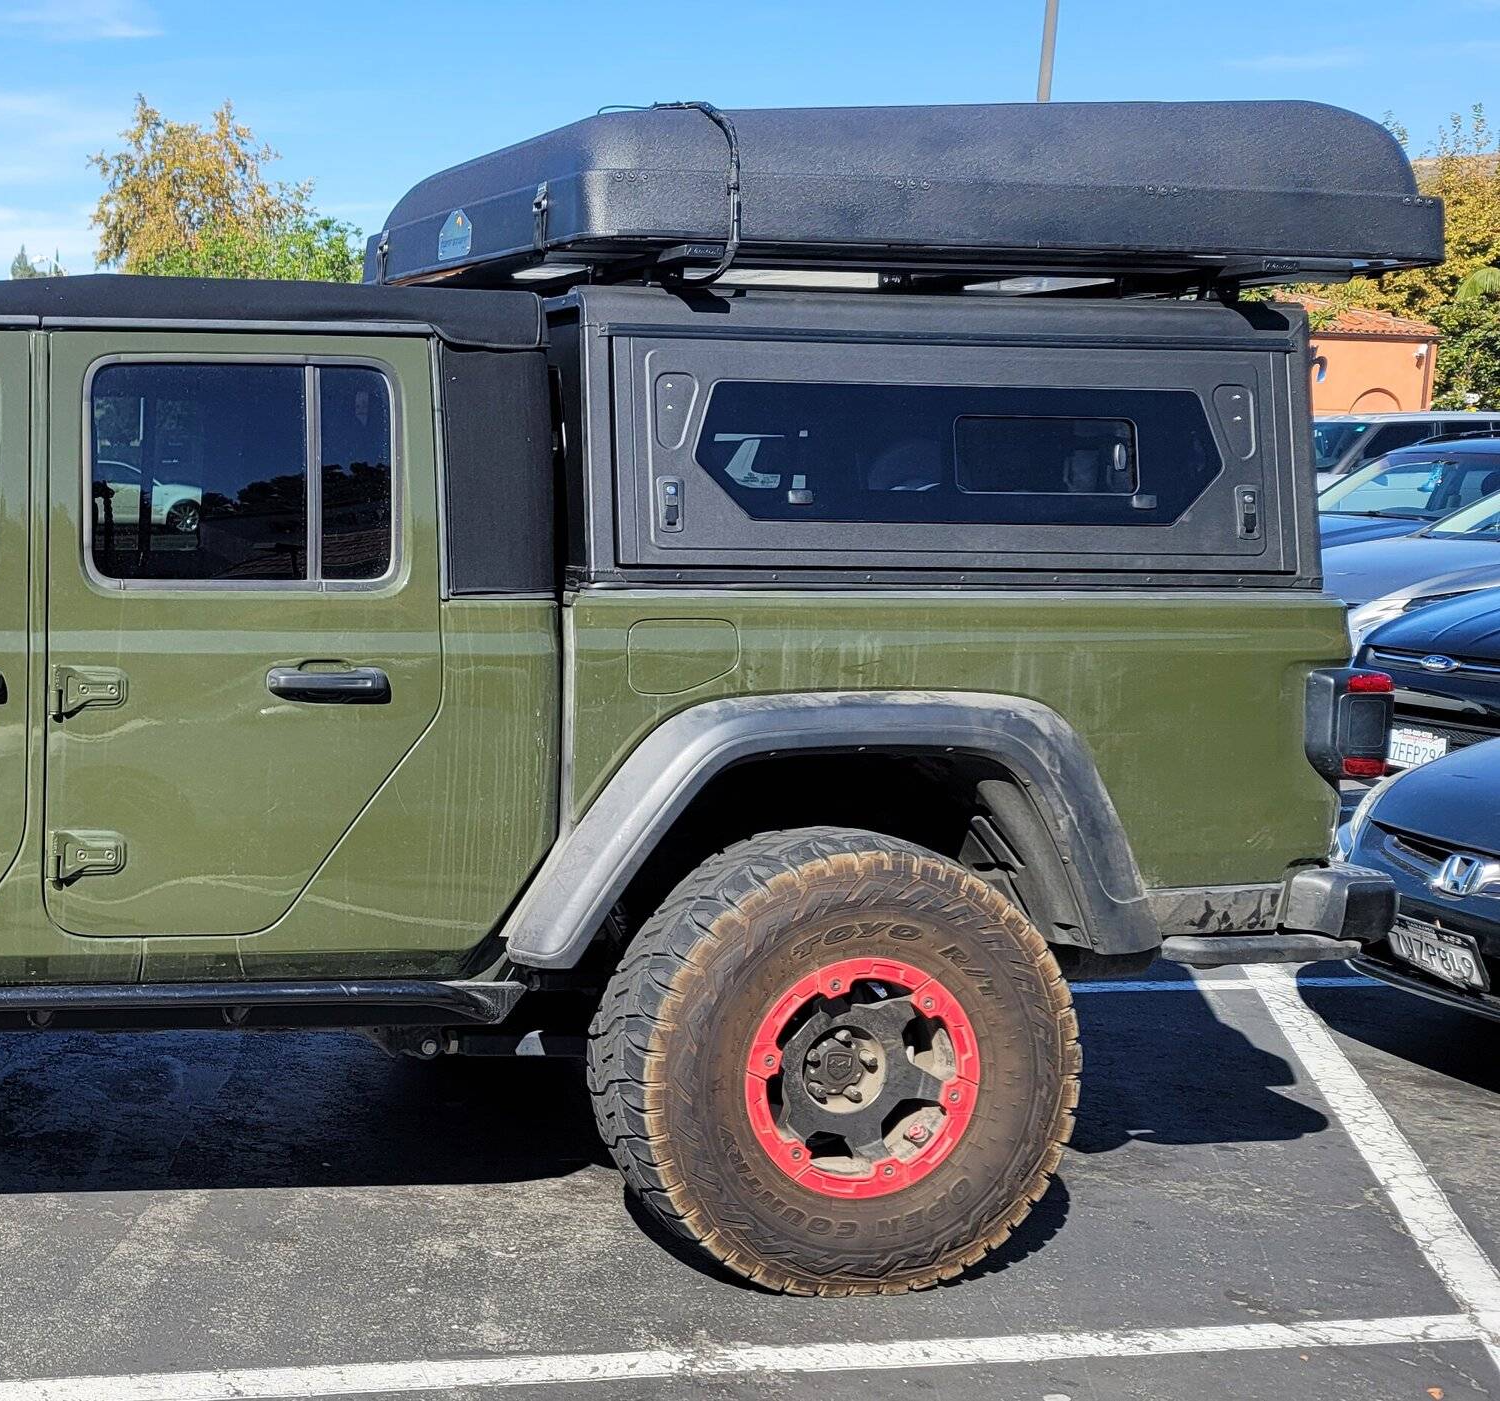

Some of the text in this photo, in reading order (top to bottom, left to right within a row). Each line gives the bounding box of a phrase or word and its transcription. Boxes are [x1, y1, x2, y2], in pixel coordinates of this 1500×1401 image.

[791, 920, 923, 960] TOYO
[717, 1124, 975, 1240] OPEN COUNTRY
